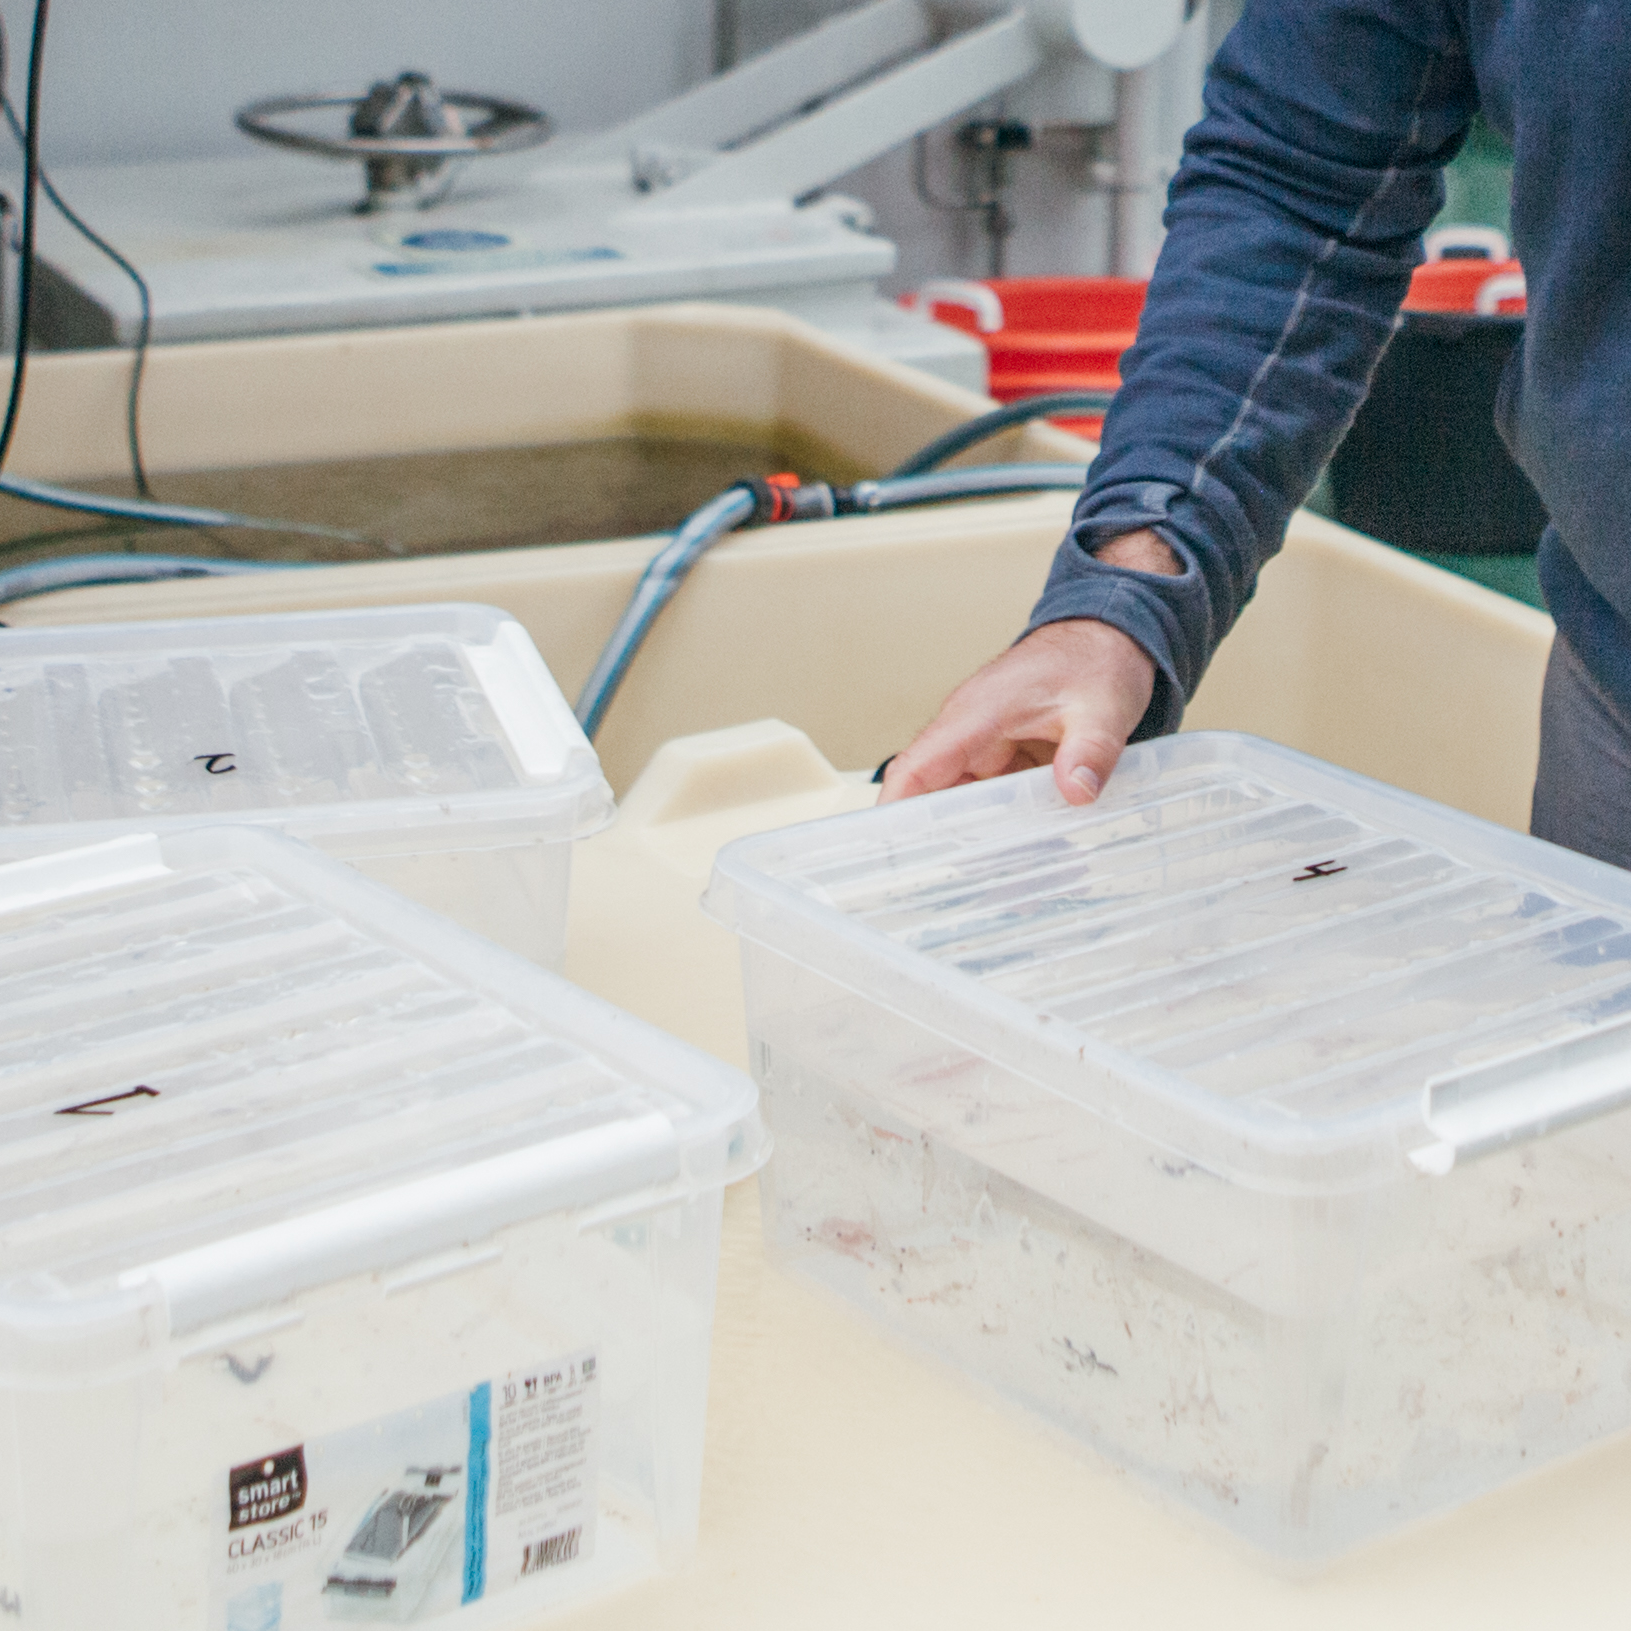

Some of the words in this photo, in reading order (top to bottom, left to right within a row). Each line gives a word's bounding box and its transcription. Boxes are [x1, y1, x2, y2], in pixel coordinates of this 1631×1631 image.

[238, 1468, 298, 1505] smart
[238, 1494, 291, 1524] store
[228, 1517, 305, 1559] CLASSIC
[310, 1507, 329, 1531] 15
